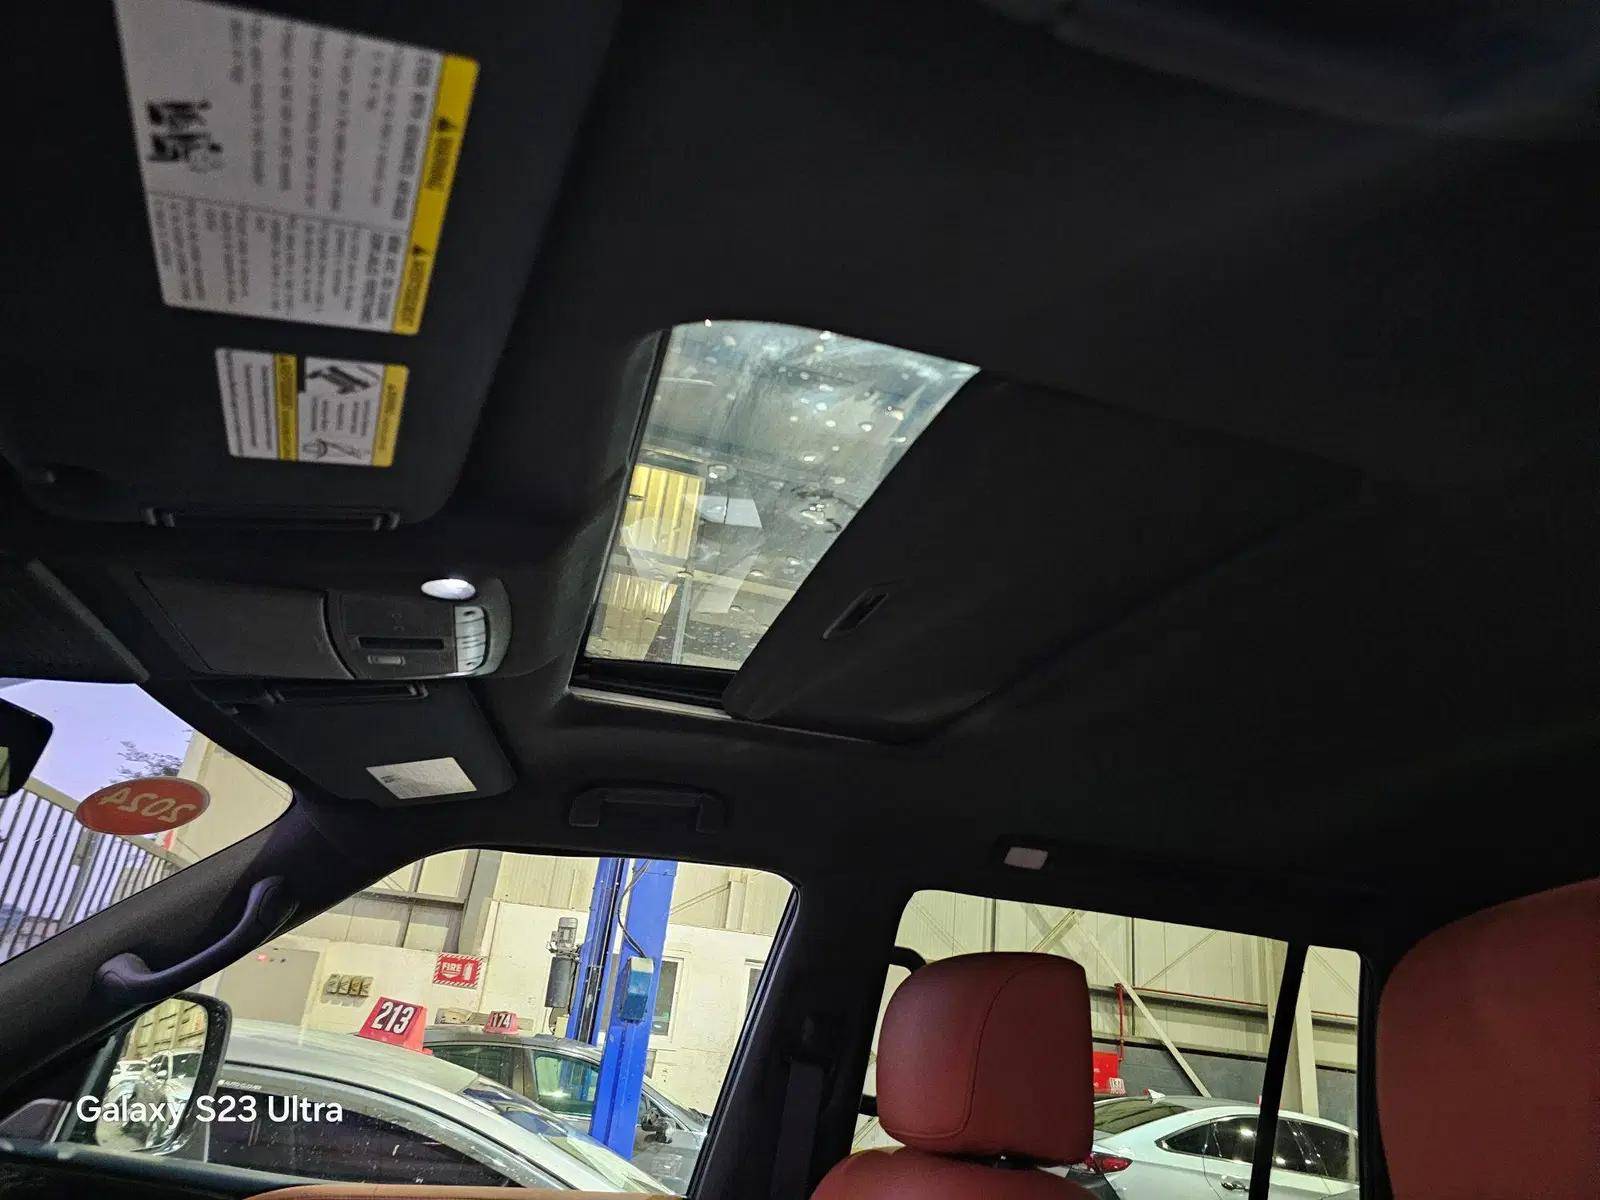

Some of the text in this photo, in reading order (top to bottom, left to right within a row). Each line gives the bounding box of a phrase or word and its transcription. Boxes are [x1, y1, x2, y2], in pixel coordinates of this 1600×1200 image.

[442, 962, 462, 971] FIRE
[370, 1001, 415, 1034] 213
[492, 1013, 511, 1028] 174
